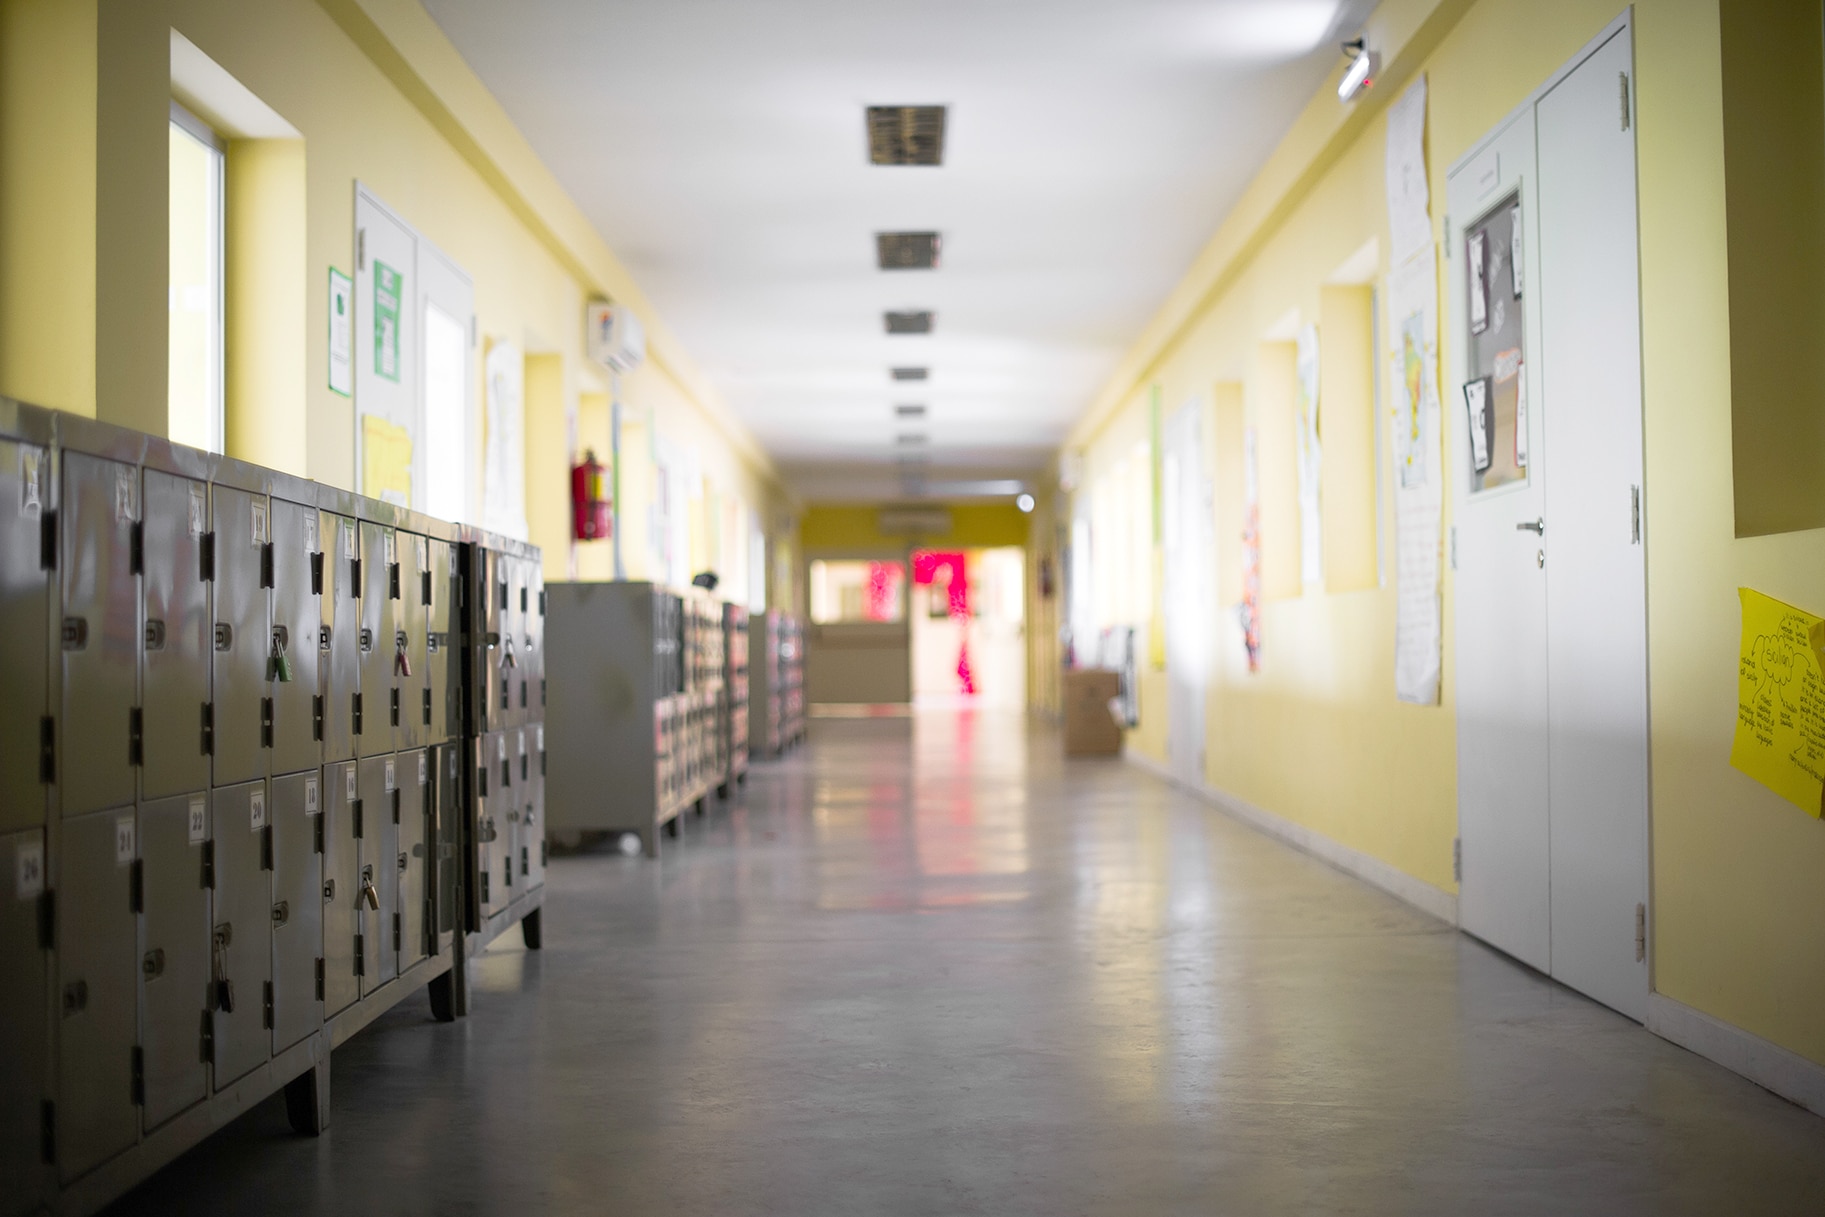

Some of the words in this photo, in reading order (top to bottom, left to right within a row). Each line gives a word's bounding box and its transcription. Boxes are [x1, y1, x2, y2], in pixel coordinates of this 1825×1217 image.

[308, 787, 315, 804] 18
[253, 801, 262, 820] 20
[192, 811, 203, 831] 22
